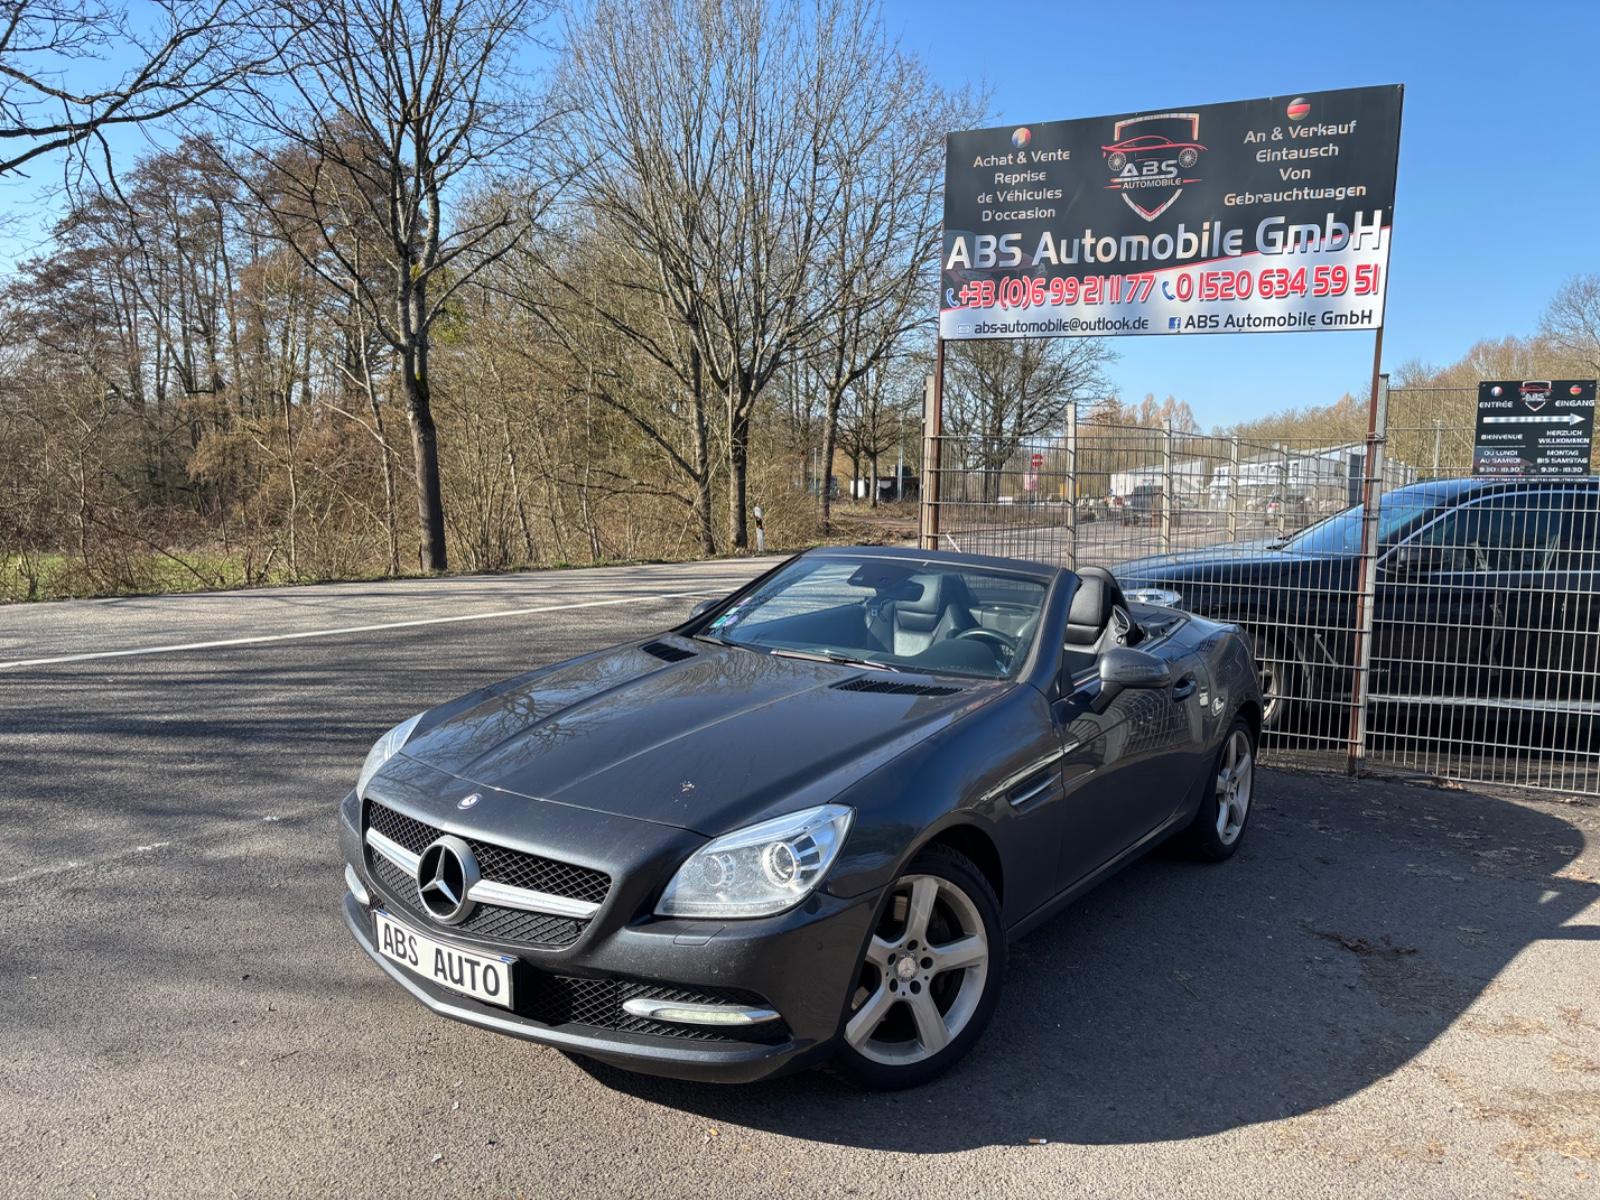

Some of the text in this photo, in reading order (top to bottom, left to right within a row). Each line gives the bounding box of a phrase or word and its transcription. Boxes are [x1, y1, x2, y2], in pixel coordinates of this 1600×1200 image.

[1244, 120, 1357, 144] An & Verkauf
[973, 148, 1071, 168] Achat & Vente
[1255, 143, 1339, 163] Eintausch
[994, 171, 1047, 185] Reprise
[1120, 160, 1178, 178] ABS
[1279, 168, 1311, 181] Von
[1122, 178, 1182, 189] AUTOMOBILE
[977, 188, 1062, 204] de Véhicules
[1224, 185, 1367, 206] Gebrauchtwagen
[982, 207, 1056, 222] D'occasion
[946, 209, 1383, 271] ABS Automobile GmbH
[959, 280, 996, 309] +33
[1049, 277, 1081, 304] 99
[1125, 273, 1156, 303] 77
[1198, 270, 1253, 299] 1520
[1258, 267, 1307, 297] 634
[1312, 264, 1350, 294] 59
[1353, 263, 1380, 295] 51
[1184, 314, 1220, 329] ABS
[1224, 312, 1316, 328] Automobile
[1321, 310, 1373, 326] GmbH
[383, 922, 501, 997] ABS AUTO
